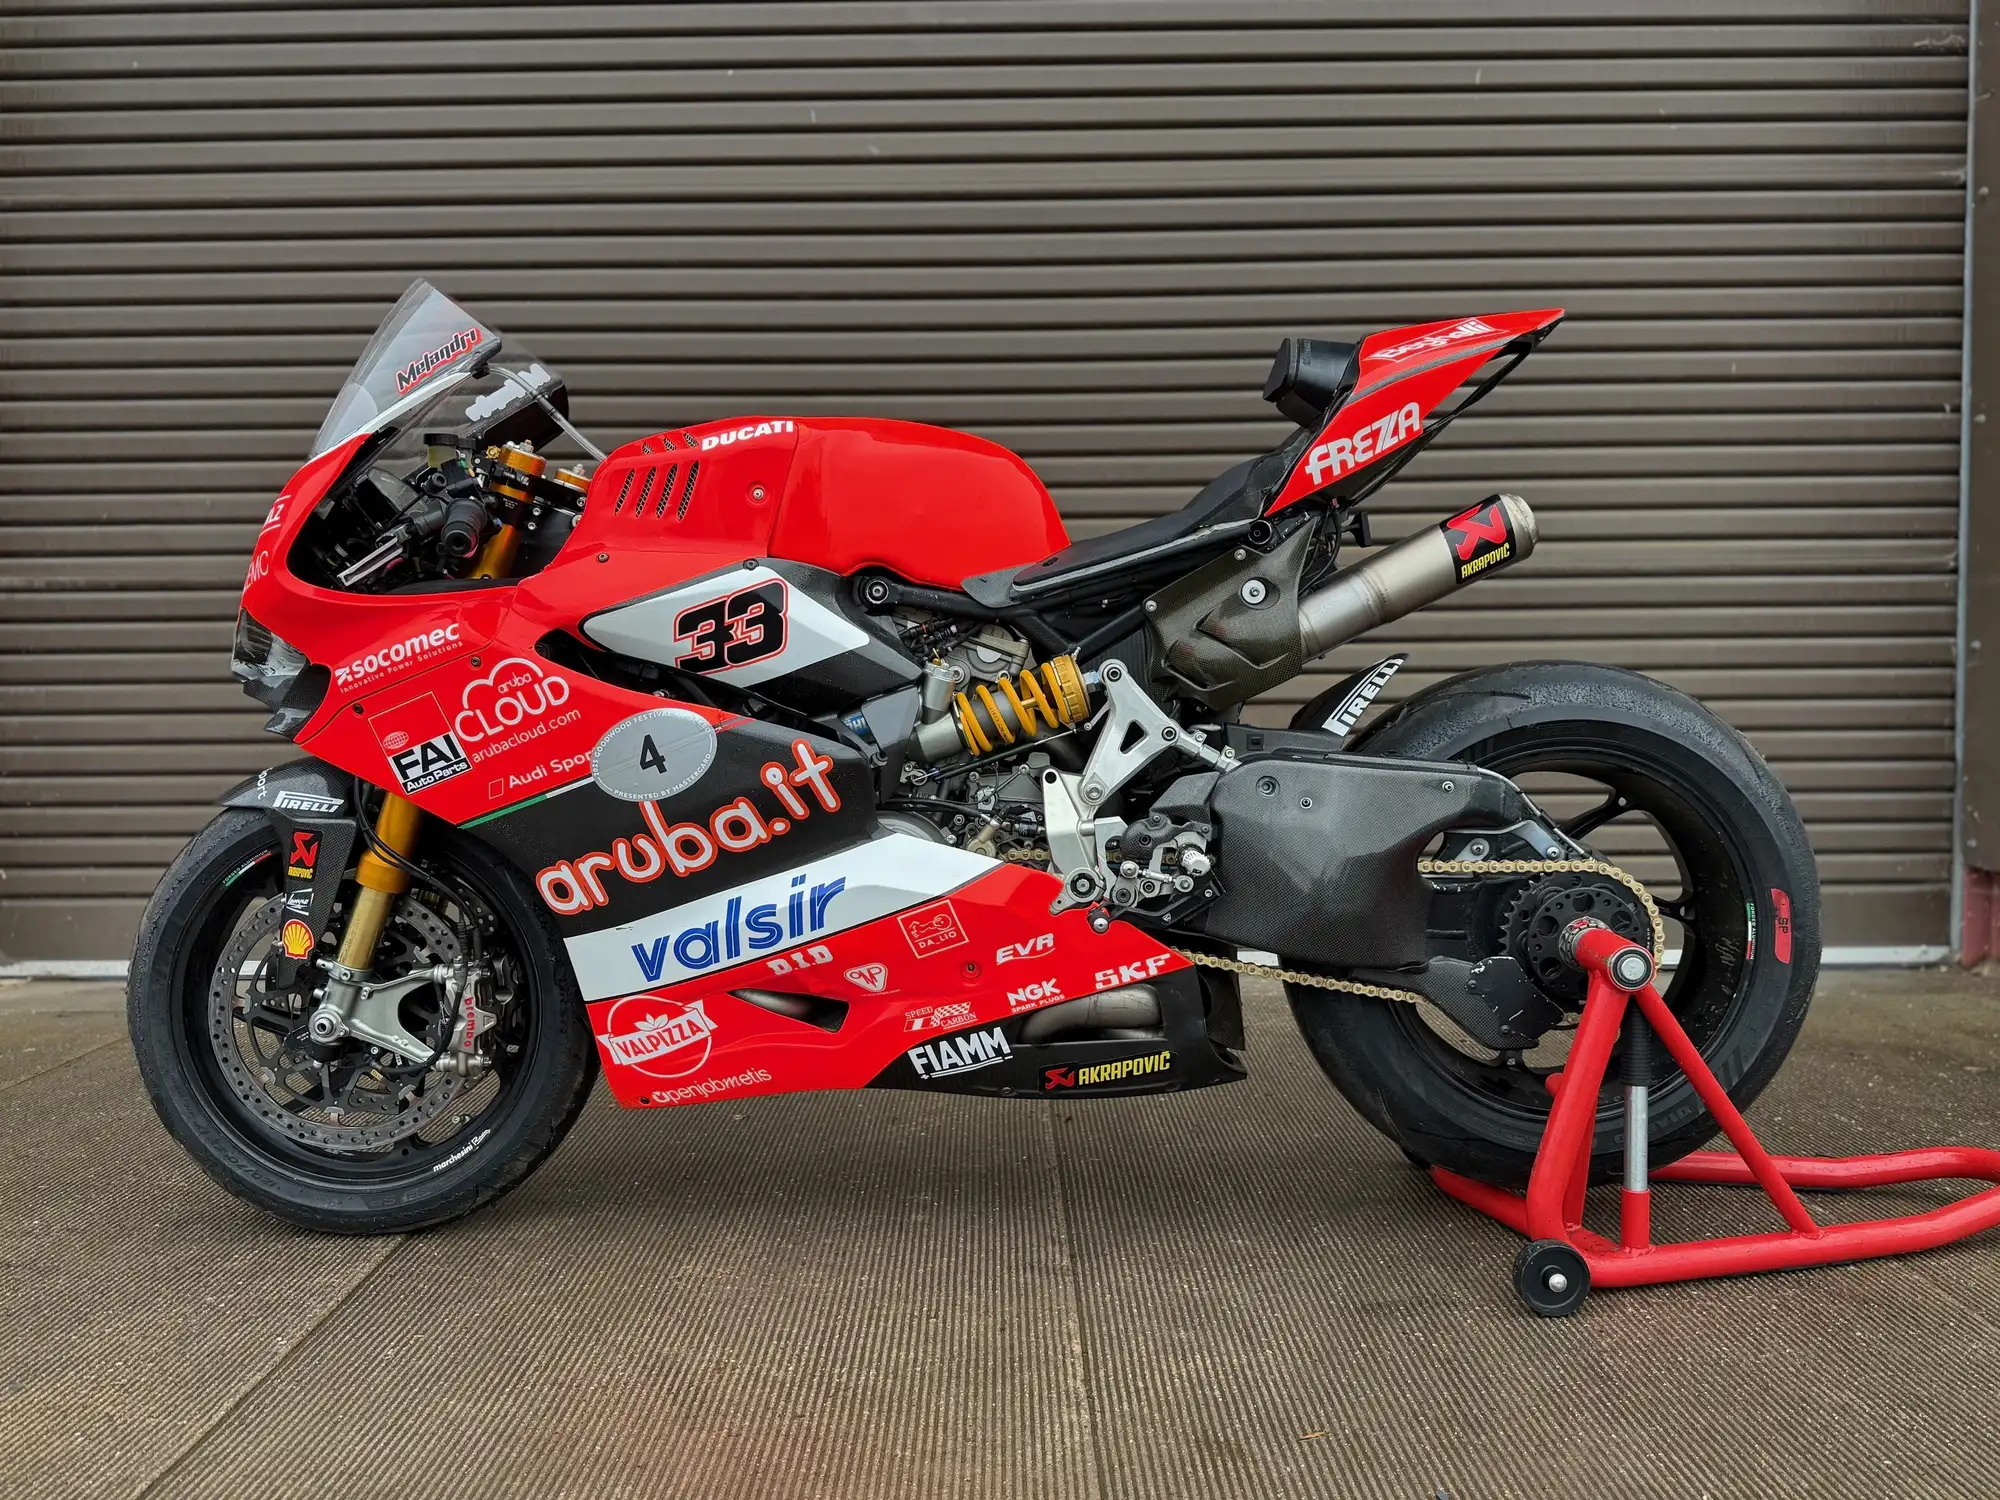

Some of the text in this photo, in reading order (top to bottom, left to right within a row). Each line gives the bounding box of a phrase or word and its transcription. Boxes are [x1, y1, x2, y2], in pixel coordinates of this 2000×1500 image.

[395, 327, 482, 395] Melandri
[701, 420, 795, 451] DUCATI
[673, 577, 789, 678] 33
[339, 640, 464, 695] Innovative Power Solutions
[351, 622, 460, 680] socomec
[497, 671, 533, 695] aruba
[1321, 658, 1405, 737] PIRELLI
[455, 675, 570, 743] CLOUD
[471, 707, 582, 764] arubacloud.com
[594, 720, 632, 758] GOODWOOD
[639, 733, 668, 775] 4
[391, 733, 463, 782] FAI
[508, 747, 595, 789] Audi Spor
[613, 753, 712, 800] PRESENTED BY MASTERCARD
[257, 766, 273, 800] port
[272, 790, 345, 813] PIRELLI
[536, 738, 842, 916] aruba.it
[631, 873, 847, 983] valsir
[1778, 917, 1789, 934] SP
[1006, 978, 1061, 1006] NGK
[1095, 953, 1172, 990] SKF
[464, 996, 477, 1048] brembo
[905, 1006, 934, 1020] SPEED
[940, 1012, 977, 1028] CARBON
[1011, 994, 1066, 1014] SPARK PLUGS
[615, 1018, 705, 1059] VALPIZZA
[907, 1026, 1012, 1075] FIAMM
[432, 1142, 474, 1173] marchesini
